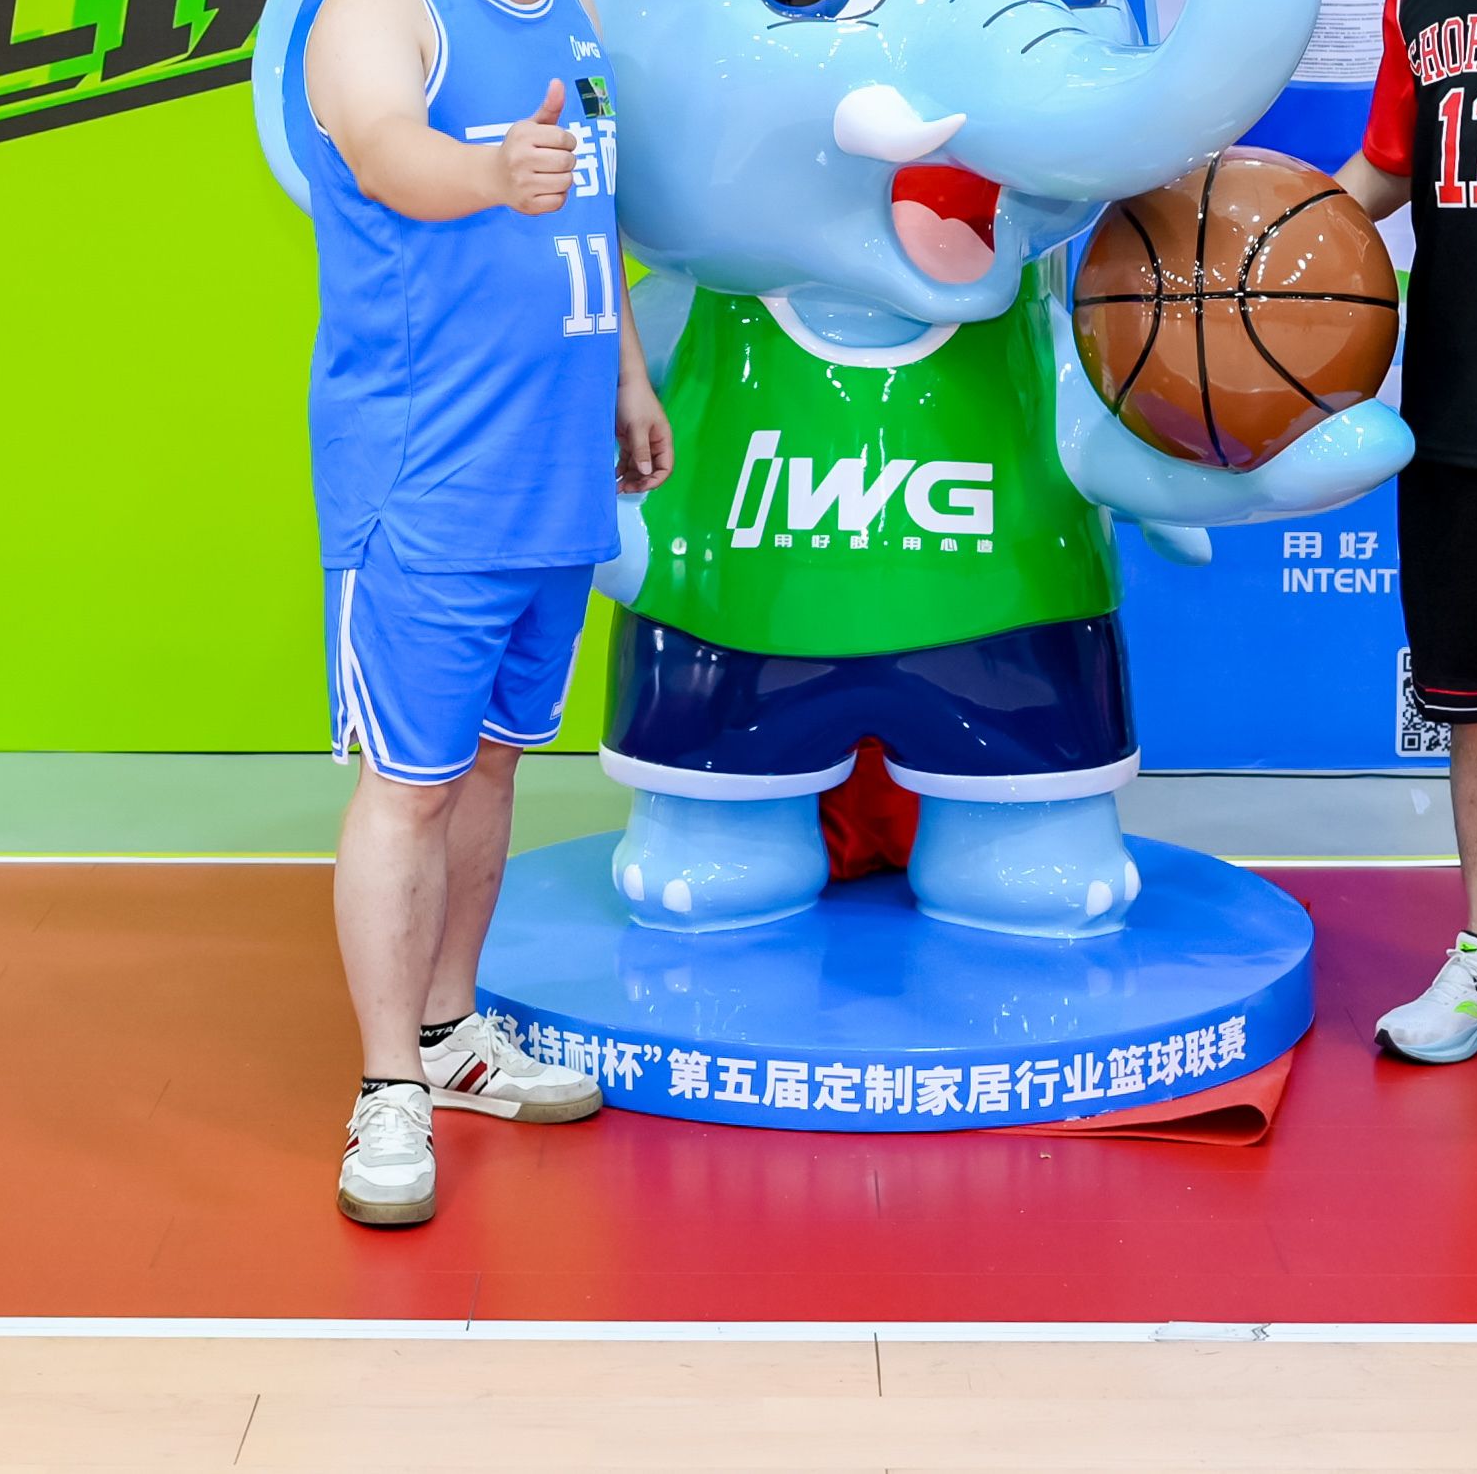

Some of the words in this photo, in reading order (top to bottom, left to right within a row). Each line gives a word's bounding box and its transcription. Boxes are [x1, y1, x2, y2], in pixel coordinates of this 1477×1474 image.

[553, 233, 618, 337] 11
[1283, 531, 1379, 559] 用好
[1283, 567, 1398, 593] INTENT
